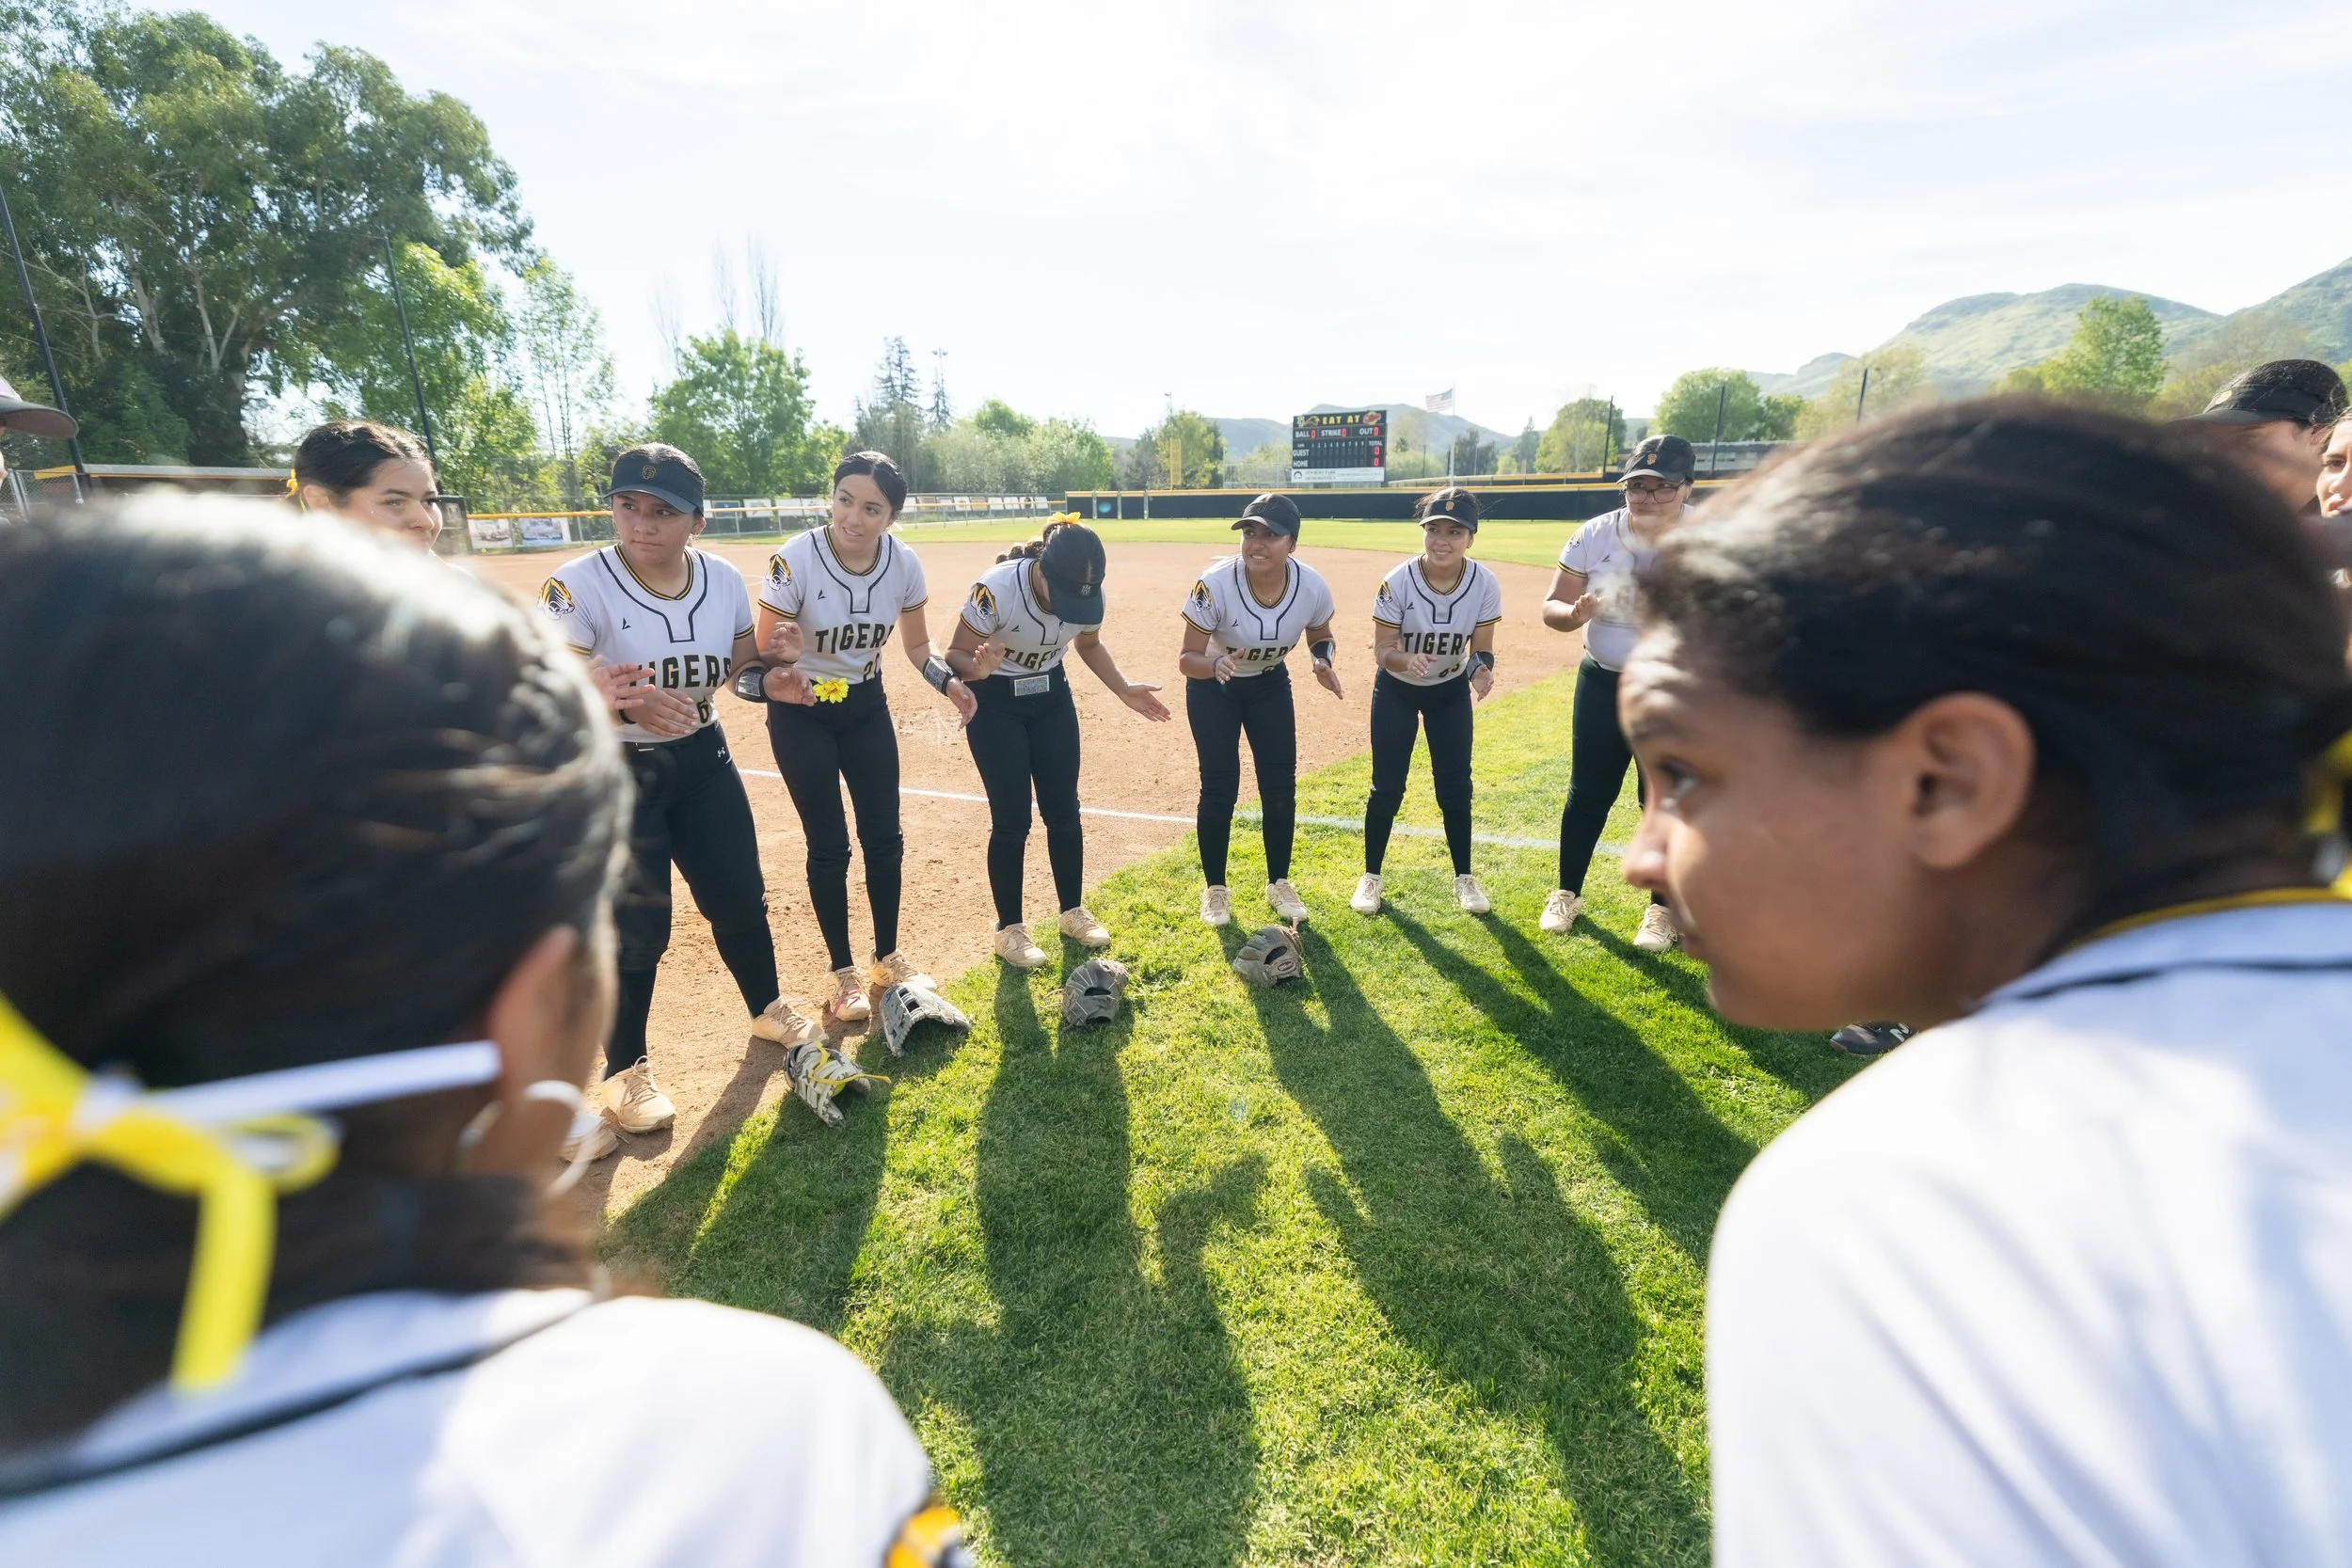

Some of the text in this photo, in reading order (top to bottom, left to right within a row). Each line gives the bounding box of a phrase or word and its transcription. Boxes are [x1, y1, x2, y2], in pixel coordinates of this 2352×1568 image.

[1323, 415, 1360, 425] EAT AT
[1311, 430, 1316, 438] 0
[1321, 428, 1346, 437] STRIKE 0
[1359, 426, 1379, 436] OUT 0
[1293, 449, 1310, 457] GUEST
[1375, 446, 1380, 455] 0
[1293, 459, 1309, 467] HOME
[1374, 457, 1379, 467] 0
